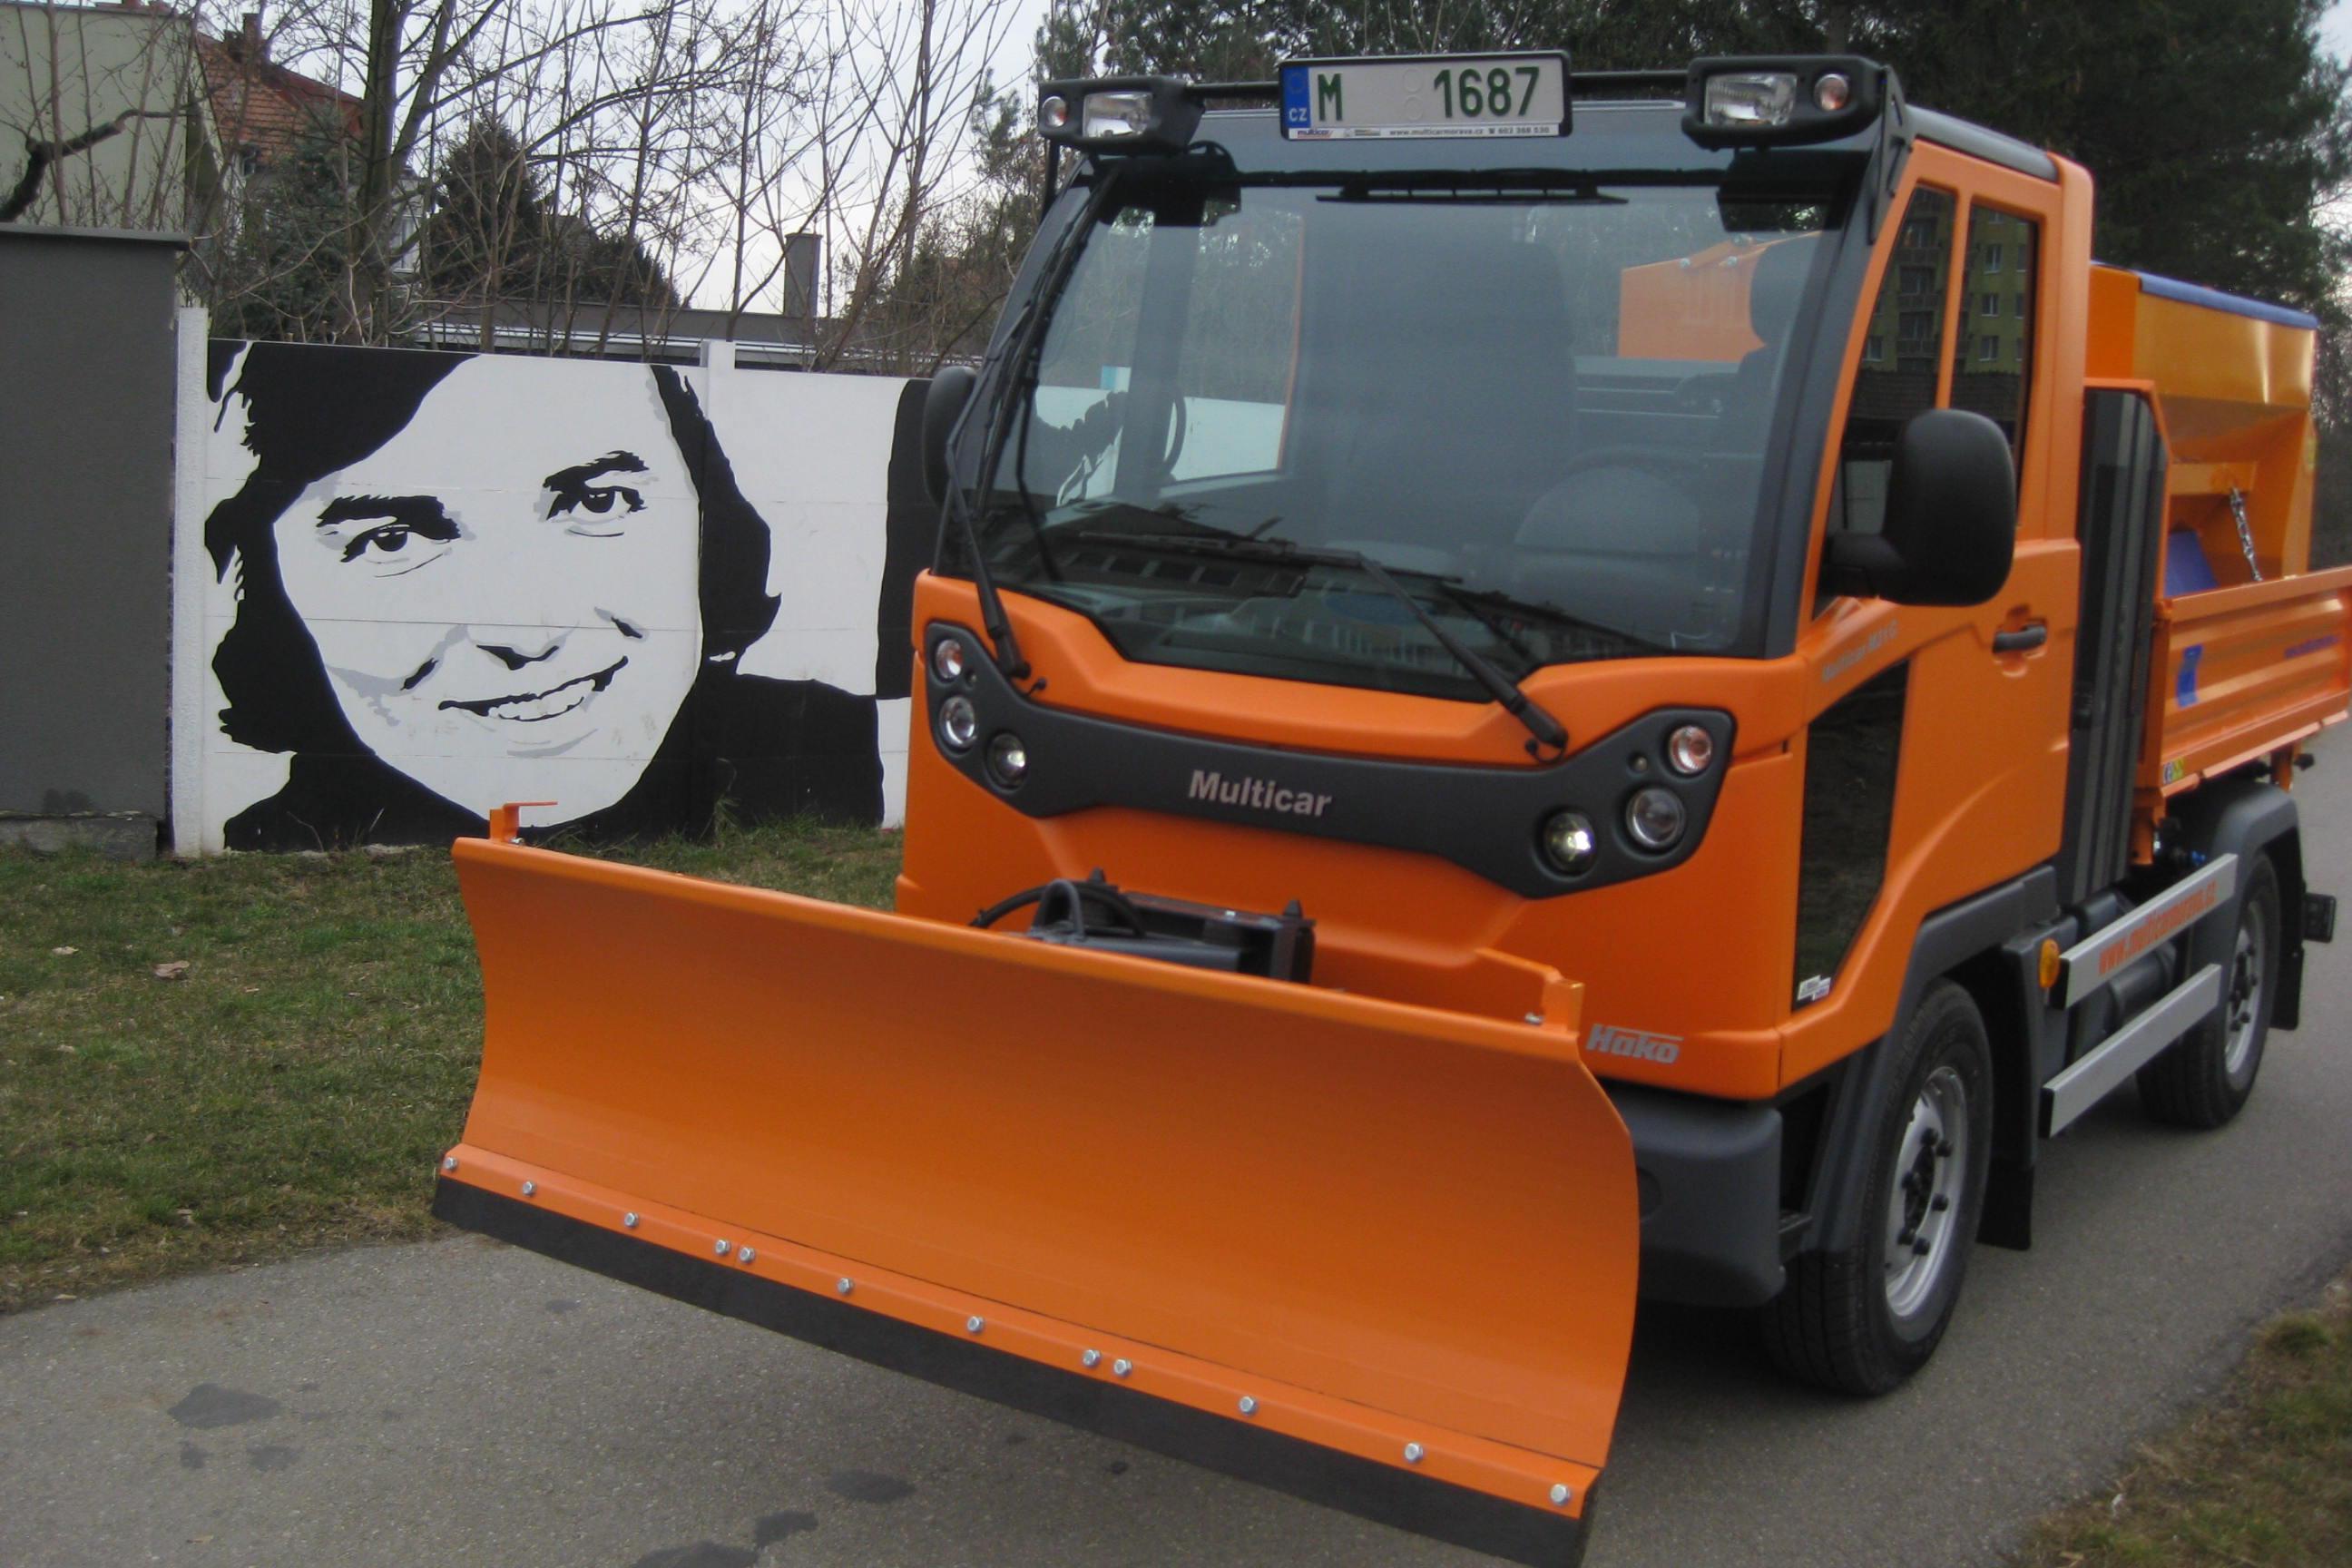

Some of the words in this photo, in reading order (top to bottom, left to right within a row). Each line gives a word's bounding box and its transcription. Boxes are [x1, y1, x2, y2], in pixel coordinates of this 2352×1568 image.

[1289, 108, 1308, 122] CZ
[1318, 73, 1343, 122] M
[1434, 66, 1540, 118] 1687
[1189, 769, 1333, 817] Multicar
[1585, 1023, 1685, 1064] Hako
